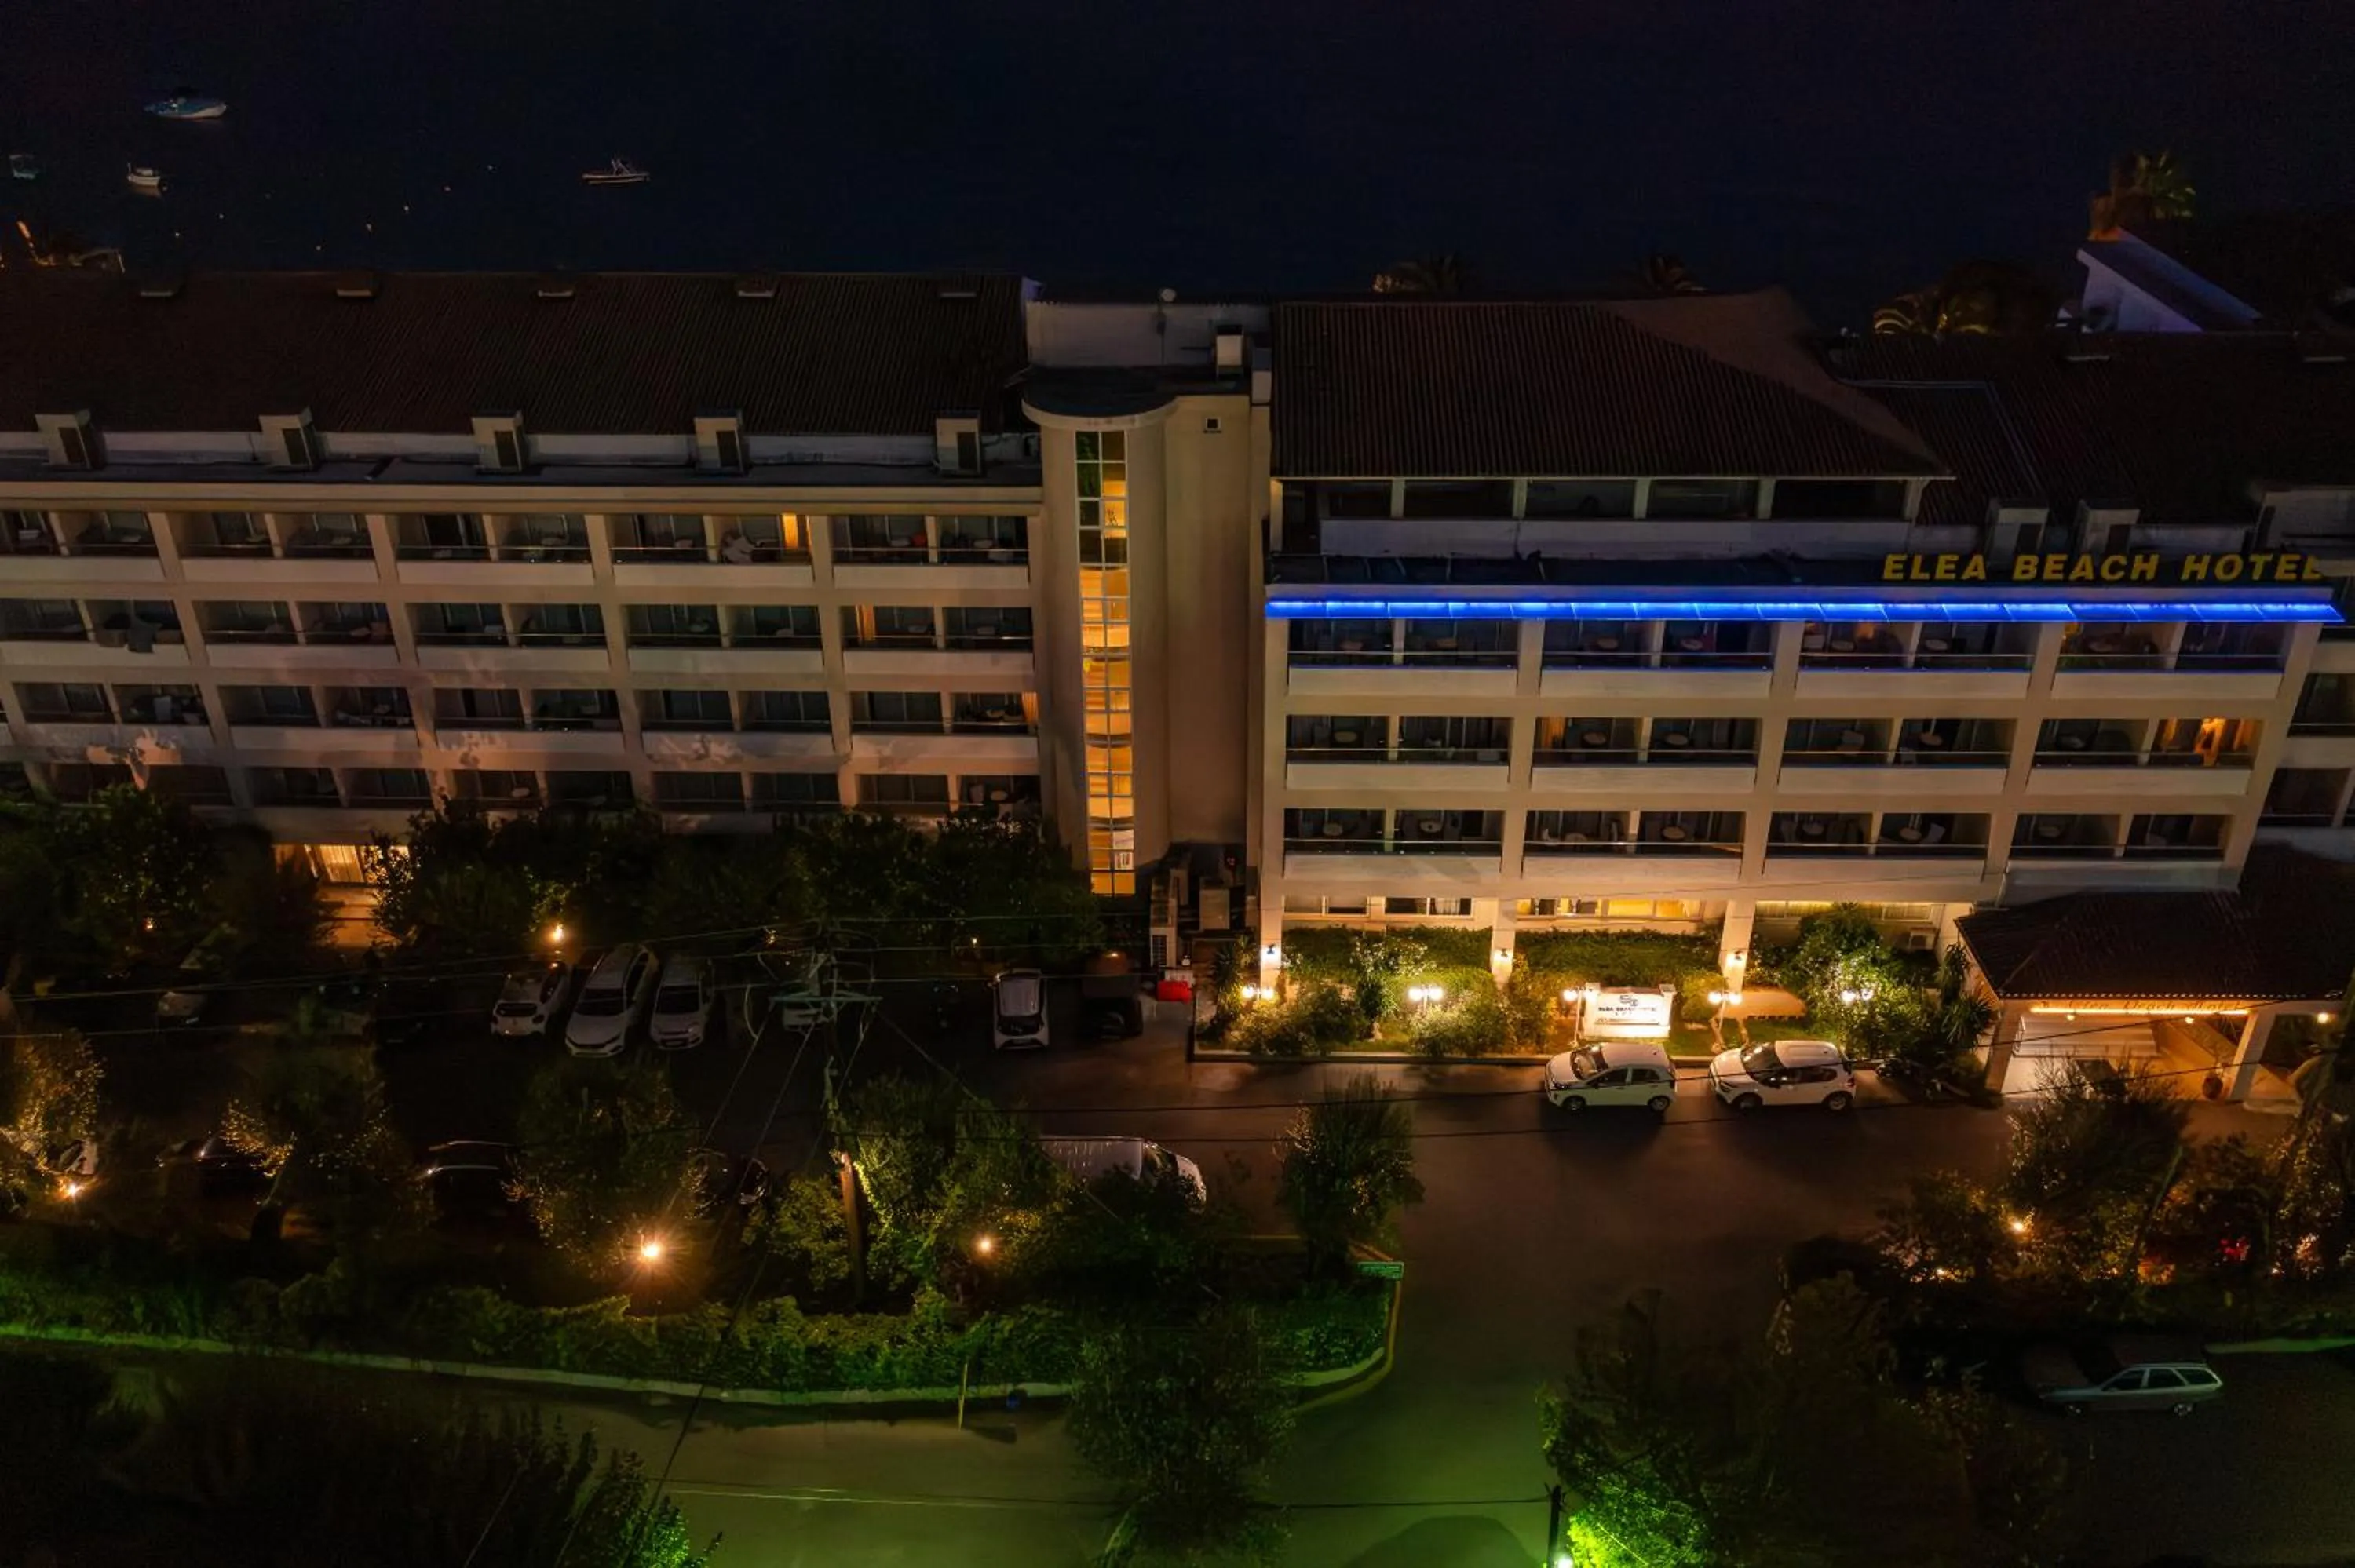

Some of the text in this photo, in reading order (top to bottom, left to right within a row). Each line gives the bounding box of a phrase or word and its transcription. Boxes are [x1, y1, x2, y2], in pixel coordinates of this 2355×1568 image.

[1882, 553, 2324, 581] ELEA BEACH HOTEL
